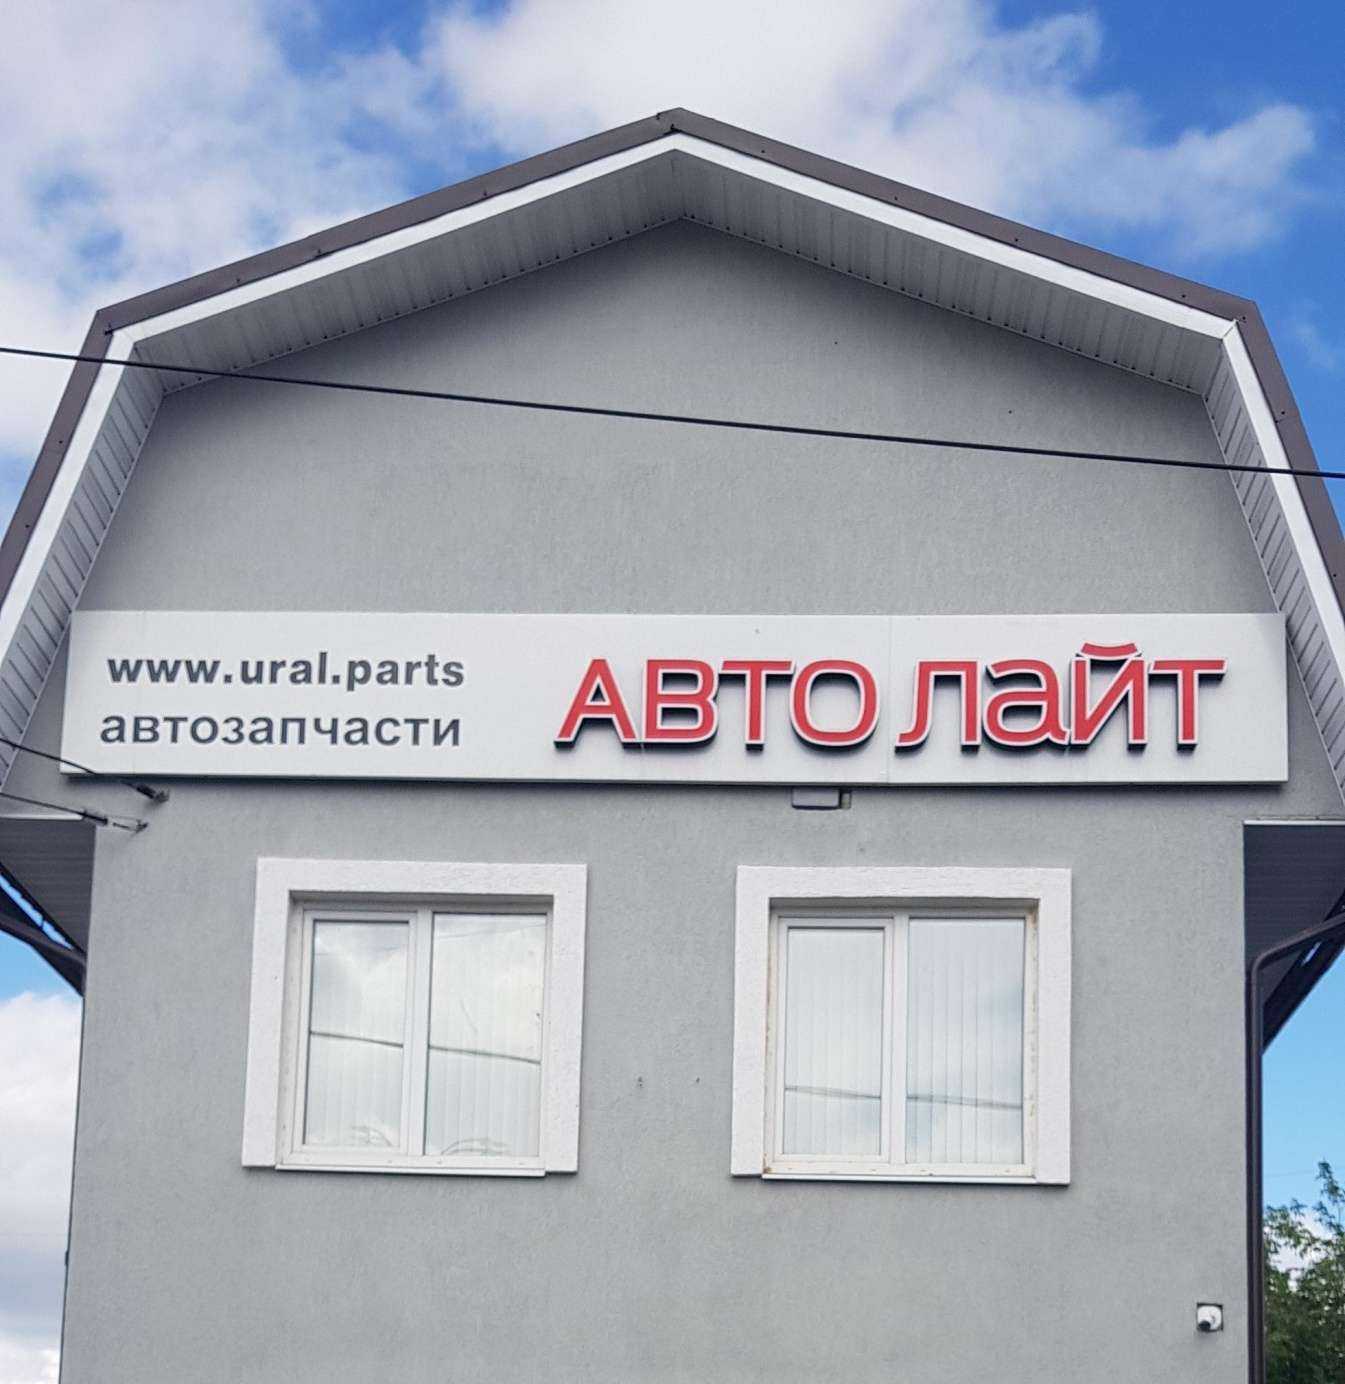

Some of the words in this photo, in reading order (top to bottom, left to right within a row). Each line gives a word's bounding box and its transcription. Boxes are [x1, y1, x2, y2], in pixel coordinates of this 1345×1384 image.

[106, 651, 466, 693] www.ural.parts
[554, 658, 880, 751] АВТО
[100, 713, 462, 747] автозапчасти
